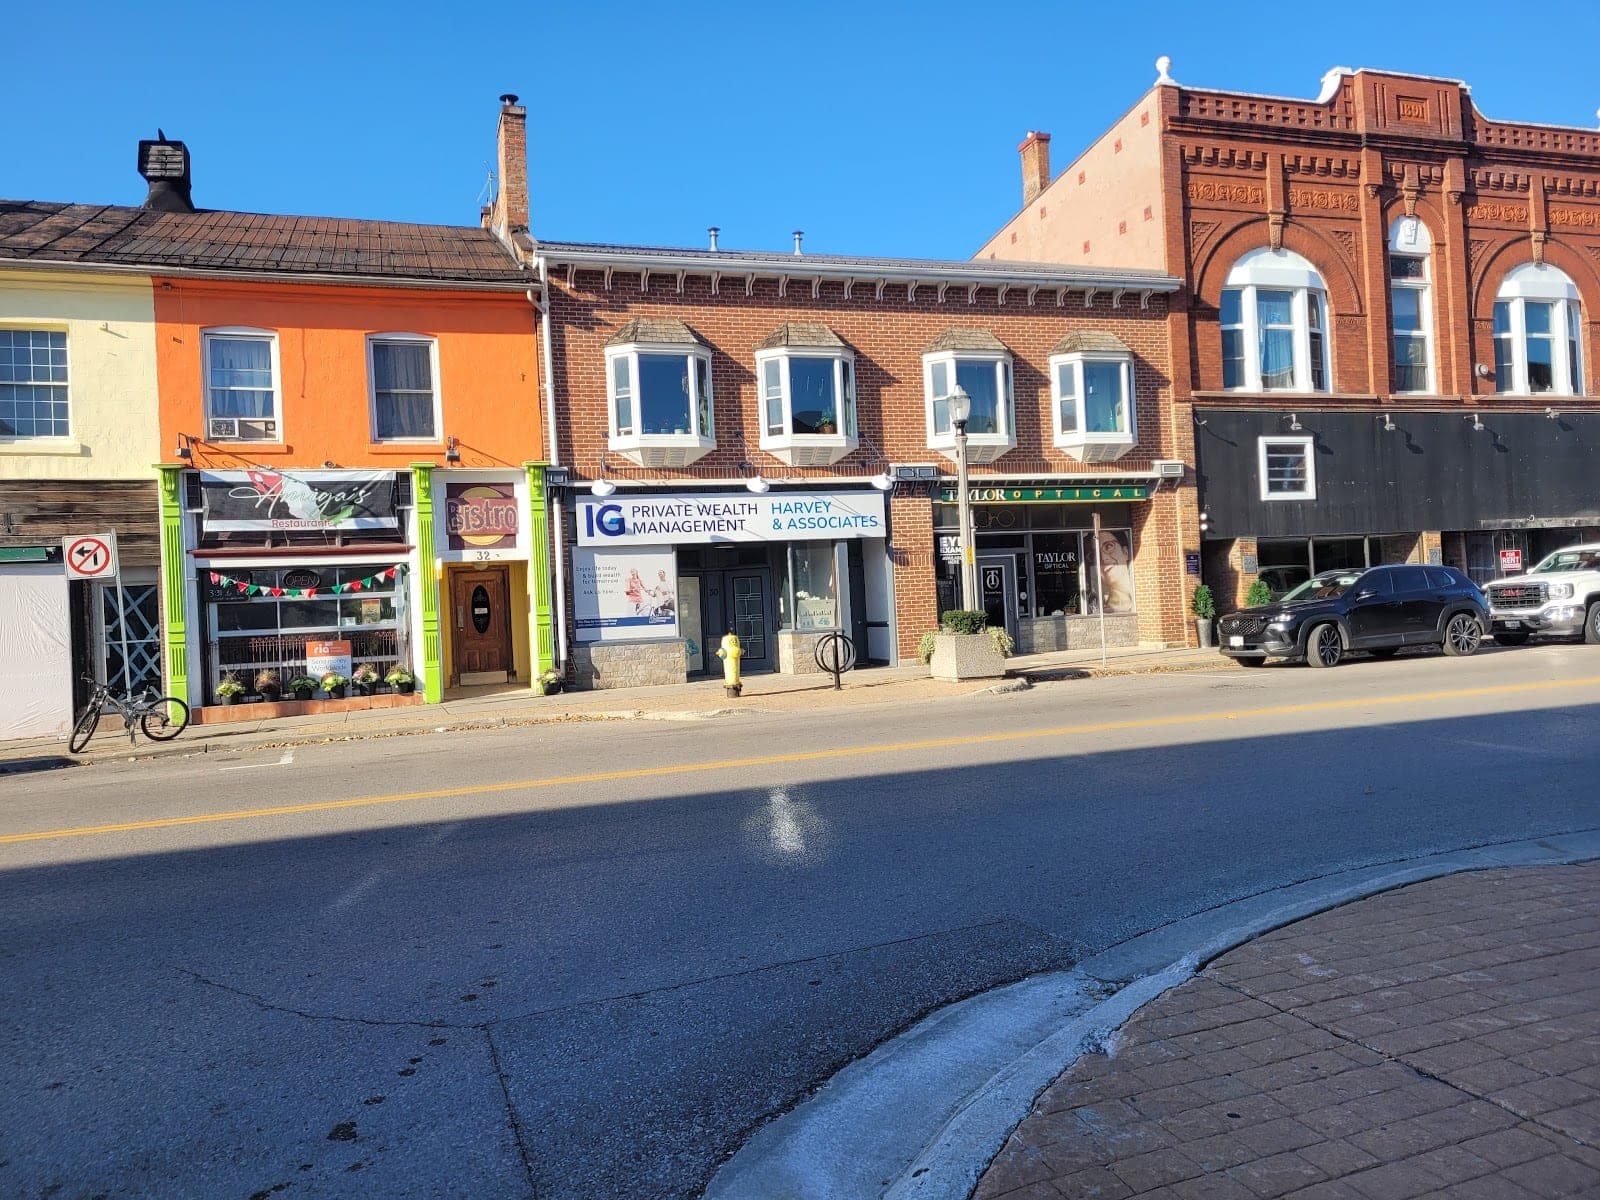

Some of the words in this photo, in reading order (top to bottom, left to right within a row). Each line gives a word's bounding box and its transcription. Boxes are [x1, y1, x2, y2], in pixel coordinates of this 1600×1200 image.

[1401, 103, 1425, 118] 1891
[946, 489, 1006, 501] TYLOR
[1013, 489, 1142, 499] OPTICAL
[771, 501, 832, 514] HARVEY
[447, 500, 518, 532] Bistro
[585, 504, 626, 537] IG
[632, 505, 693, 518] PRIVATE
[696, 503, 758, 516] WEALTH
[772, 518, 783, 530] &
[787, 515, 878, 530] ASSOCIATES
[633, 519, 746, 534] MANAGEMENT
[477, 551, 491, 560] 32
[1036, 552, 1077, 563] TAYLOR
[286, 575, 316, 586] OPEN
